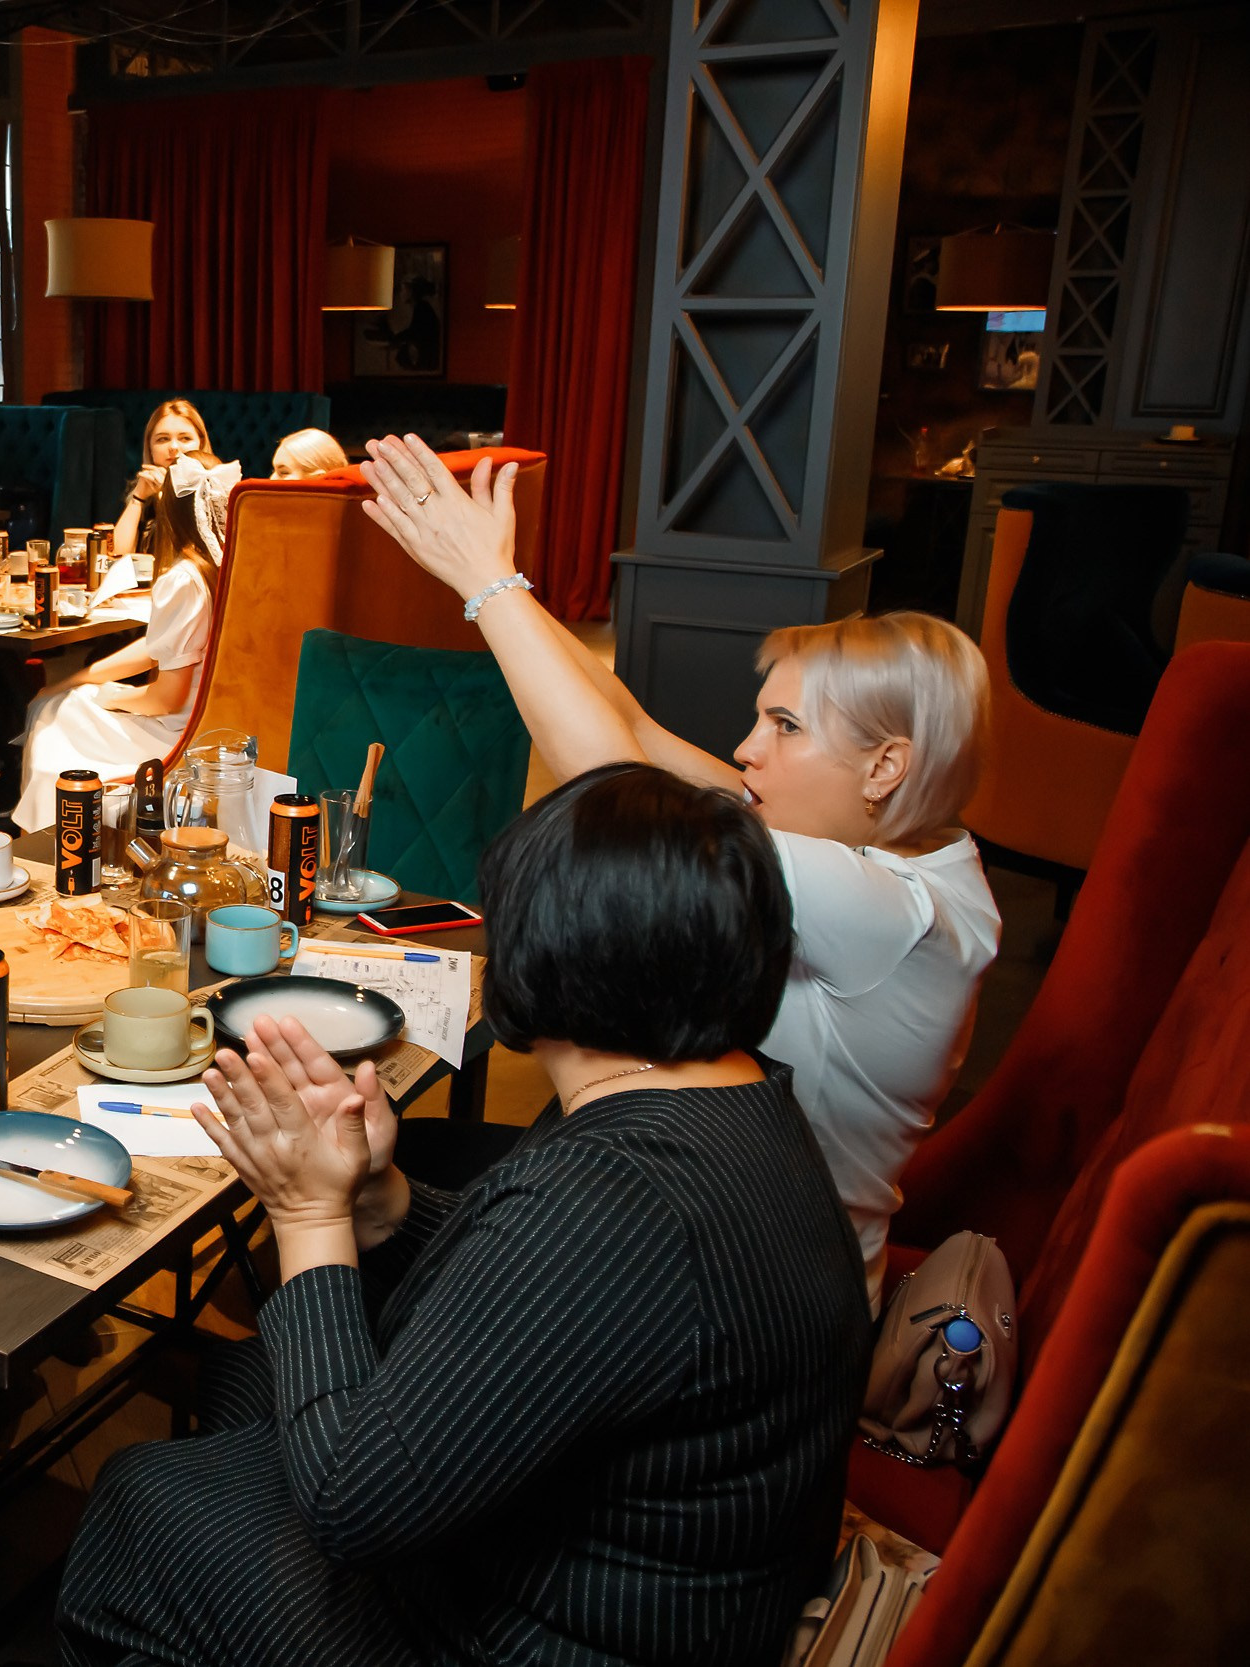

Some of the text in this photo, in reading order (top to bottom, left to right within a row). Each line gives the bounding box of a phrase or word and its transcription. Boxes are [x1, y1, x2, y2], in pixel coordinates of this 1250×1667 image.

[145, 783, 155, 797] 13
[61, 799, 83, 870] VOLT
[298, 826, 318, 902] VOLT
[270, 877, 283, 903] 8
